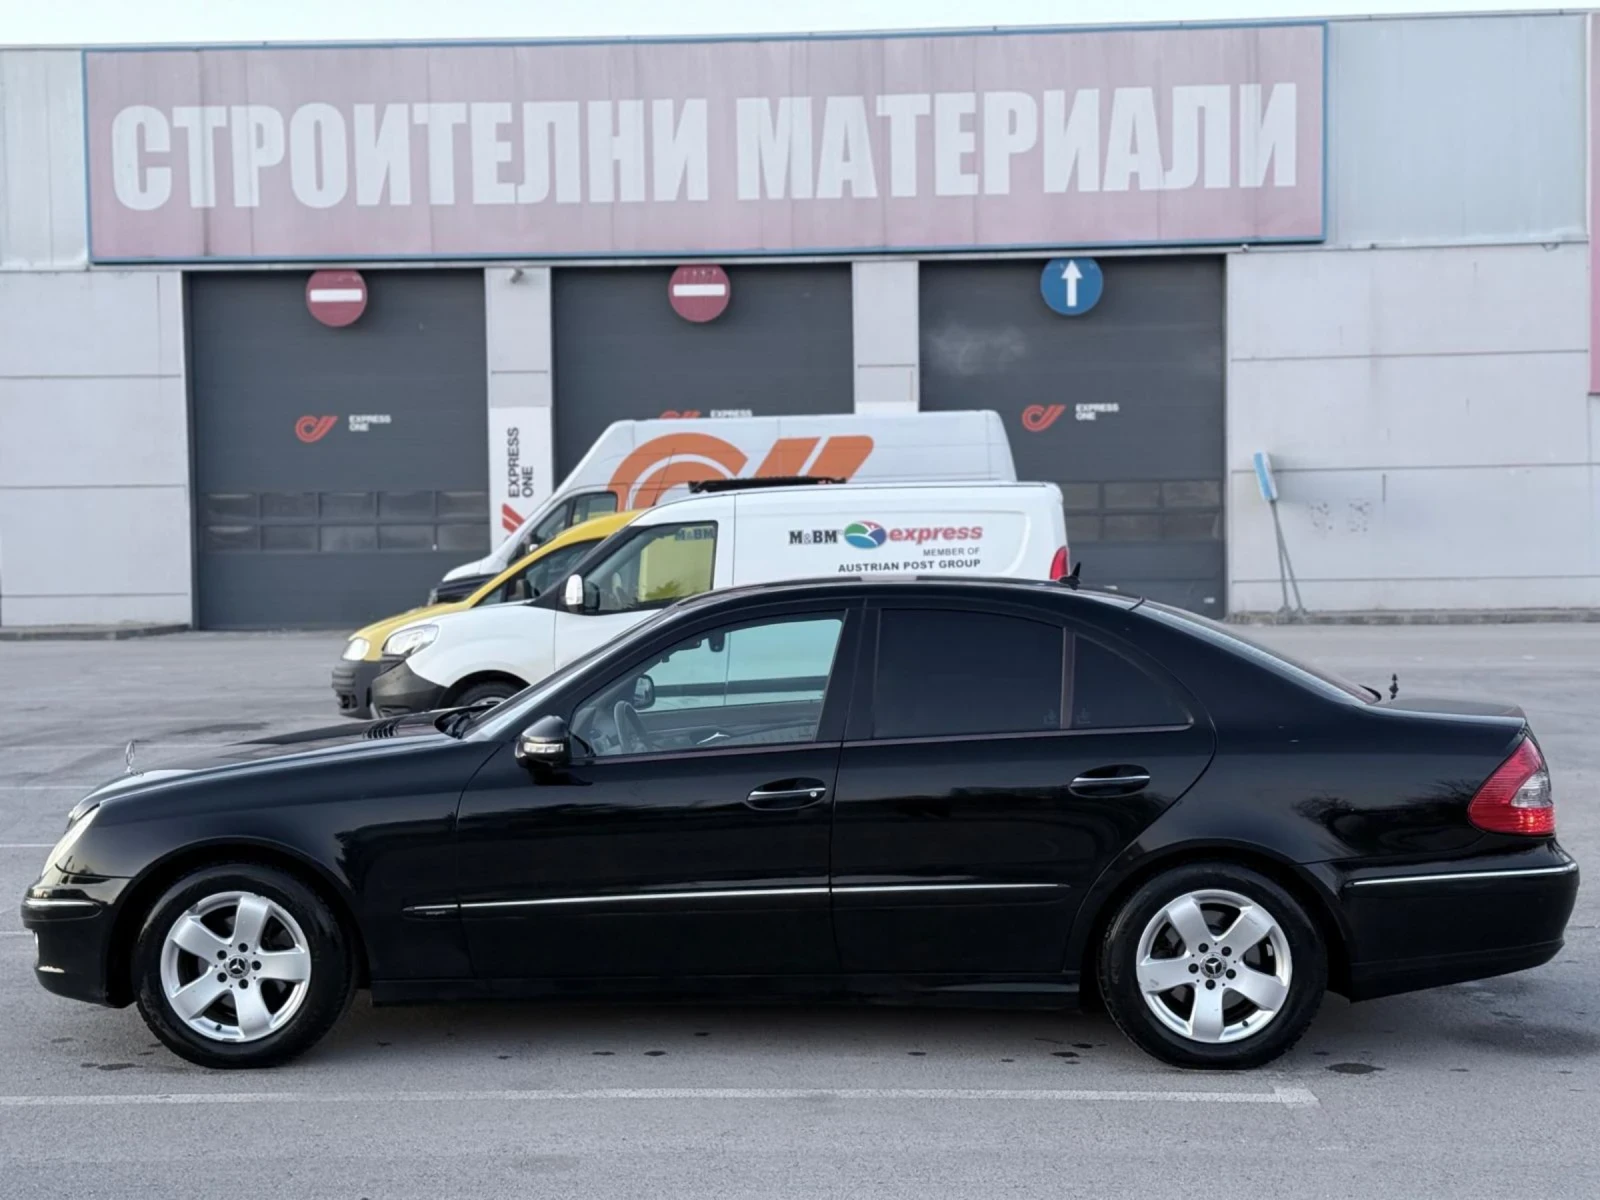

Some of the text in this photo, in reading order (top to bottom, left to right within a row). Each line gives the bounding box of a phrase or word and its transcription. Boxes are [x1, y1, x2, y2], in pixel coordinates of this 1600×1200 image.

[111, 82, 1297, 211] СТРОИТЕЛНИ МАТЕРИАЛИ
[1075, 402, 1120, 412] EXPRESS
[348, 414, 392, 424] EXPRESS
[1075, 411, 1096, 421] ONE
[348, 422, 369, 432] ONE
[507, 427, 520, 498] EXPRESS
[521, 466, 534, 498] ONE
[888, 525, 983, 545] express
[922, 547, 980, 557] MEMBER OF
[838, 559, 981, 573] AUSTRIAN POST GROUP
